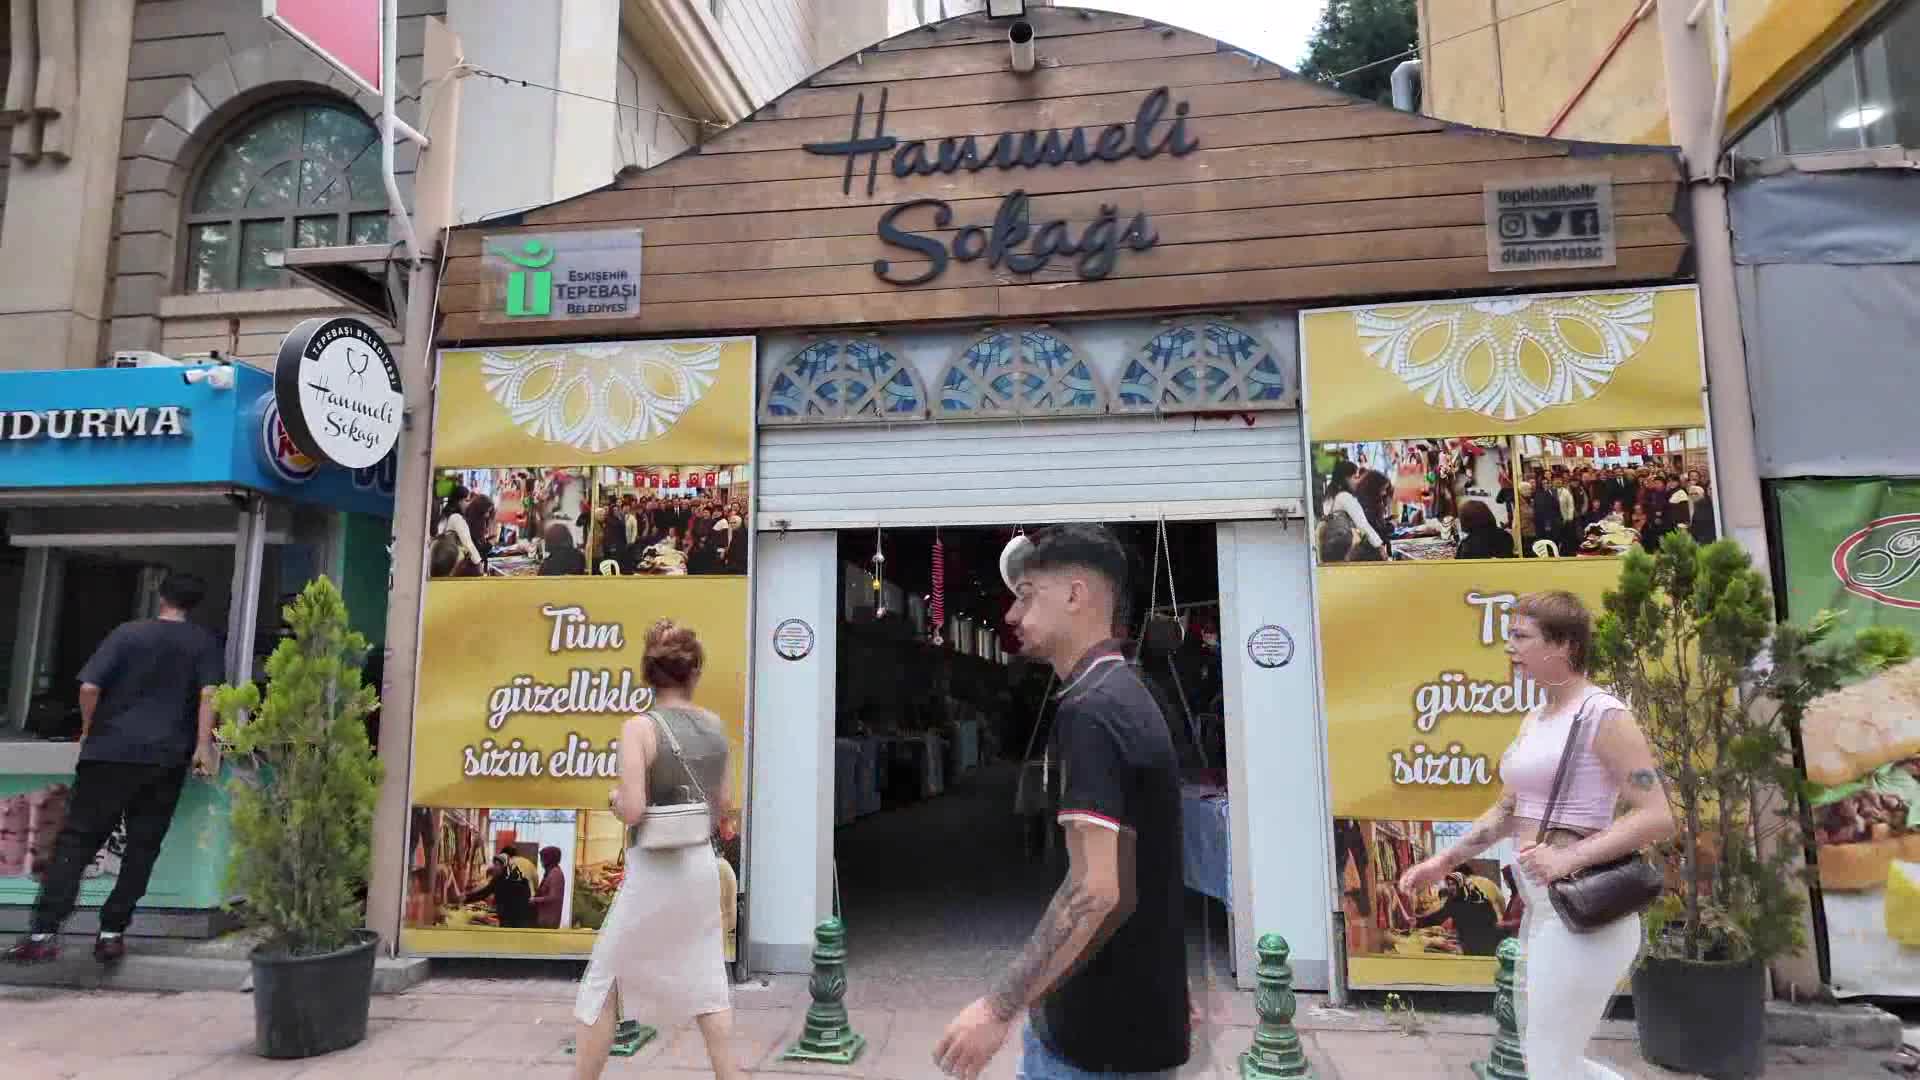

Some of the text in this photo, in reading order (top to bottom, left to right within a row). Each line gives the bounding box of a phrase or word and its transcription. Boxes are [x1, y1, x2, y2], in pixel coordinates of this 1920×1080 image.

[873, 188, 1160, 287] Sokağı
[312, 326, 353, 355] TEPEBAŞI
[0, 404, 184, 441] DURMA
[542, 604, 624, 652] Tüm
[463, 739, 543, 777] sizin
[1391, 743, 1493, 786] sizin
